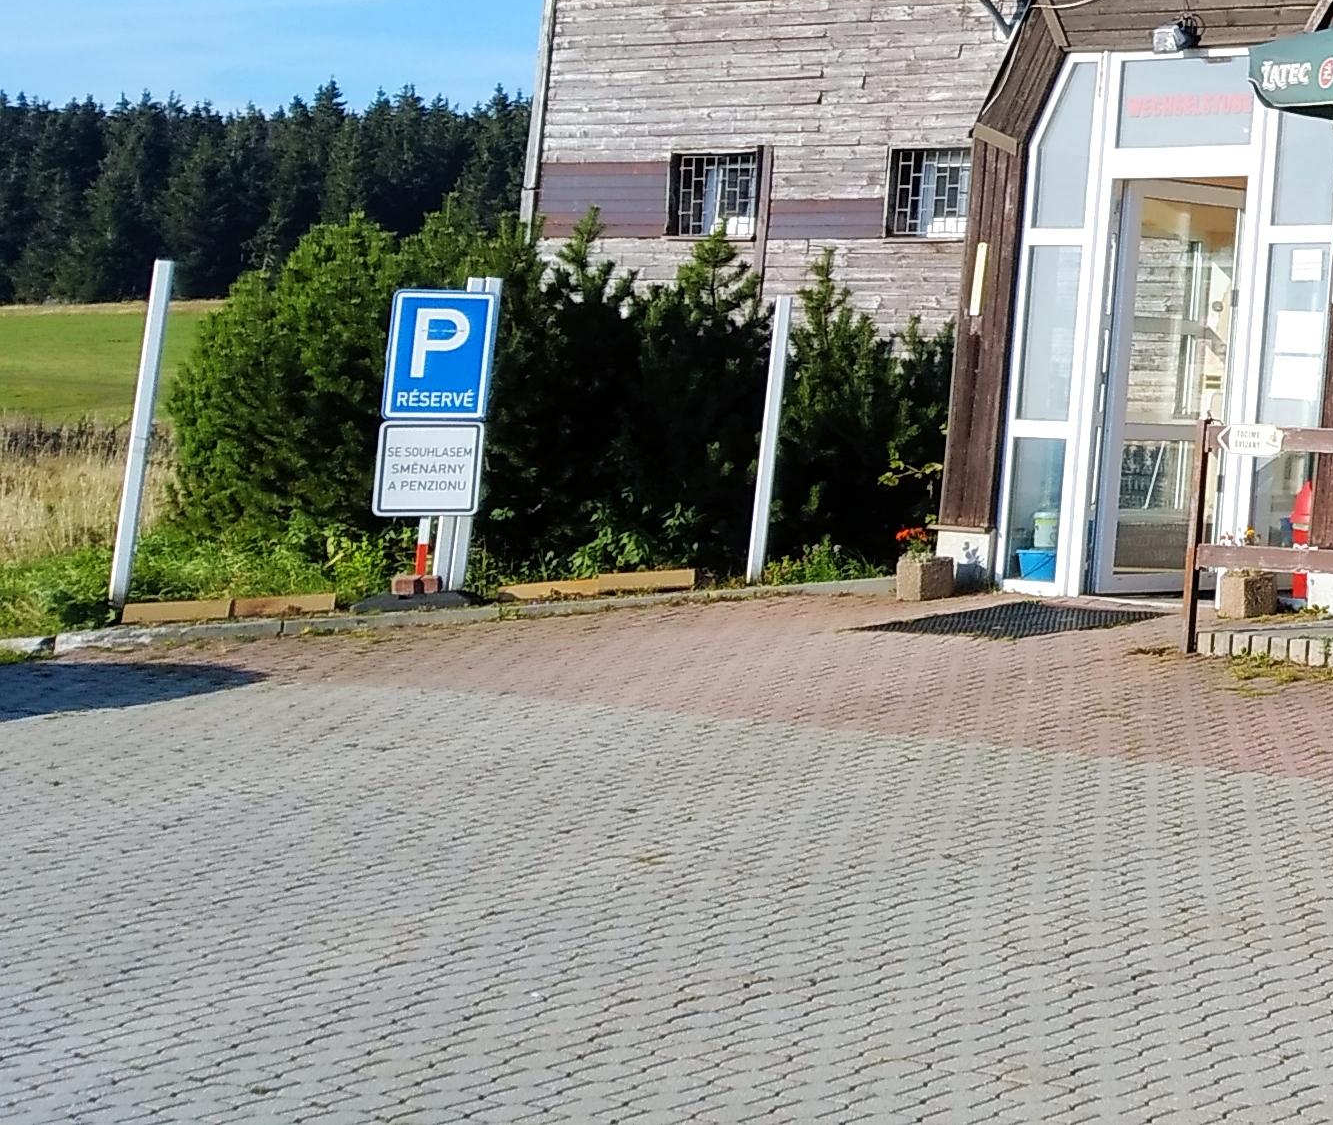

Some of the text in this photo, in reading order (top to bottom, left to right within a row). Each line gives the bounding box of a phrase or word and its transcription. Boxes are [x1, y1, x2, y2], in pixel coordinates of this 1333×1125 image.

[1261, 60, 1312, 92] ŽATEC
[1128, 92, 1253, 118] WECHSELSTUBE
[410, 308, 470, 378] P
[396, 388, 474, 407] RÉSERVÉ
[387, 446, 473, 458] SE SOUHLASEM
[391, 461, 466, 475] SMĚNÁRNY
[387, 480, 467, 492] A PENZIONU
